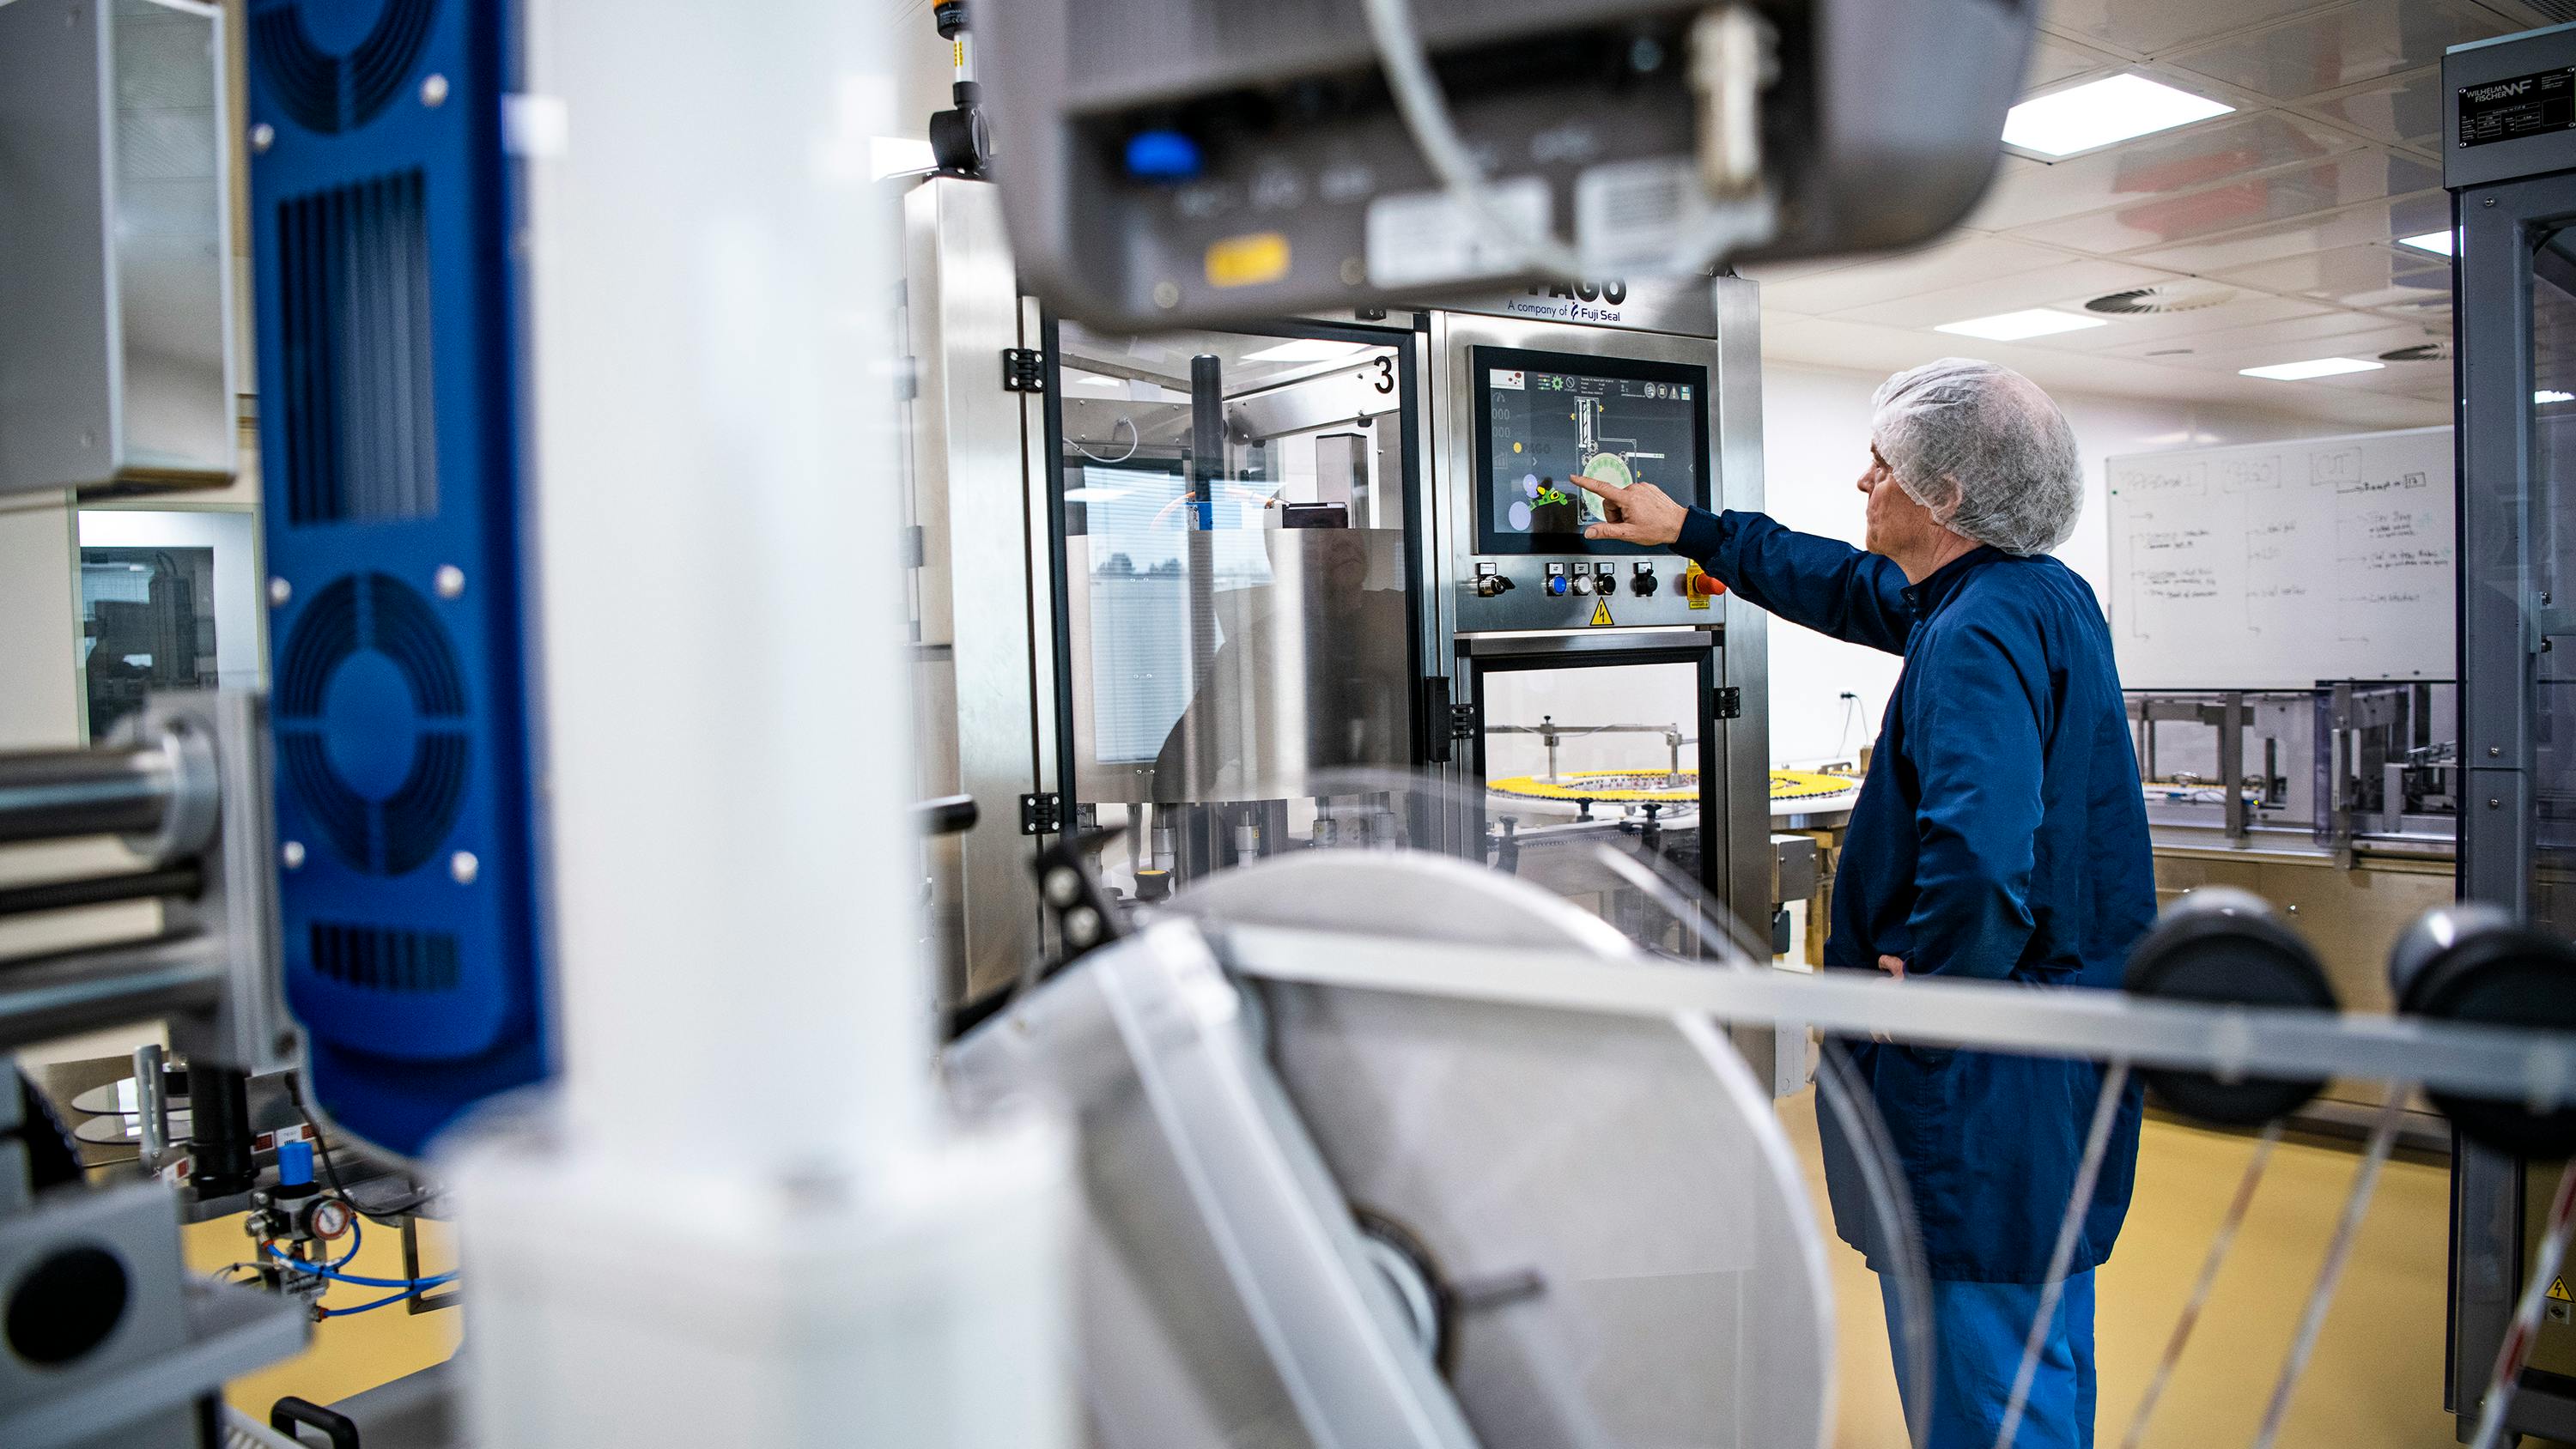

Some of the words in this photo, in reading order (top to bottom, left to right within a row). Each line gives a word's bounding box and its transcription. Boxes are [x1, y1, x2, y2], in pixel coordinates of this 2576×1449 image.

[2467, 86, 2502, 98] WILHELM
[2475, 91, 2506, 102] FISCHER
[1508, 300, 1515, 311] A
[1517, 302, 1557, 318] company
[1559, 305, 1567, 315] of
[1581, 308, 1599, 321] Fuji
[1601, 310, 1620, 321] Seal
[1374, 355, 1394, 394] 3
